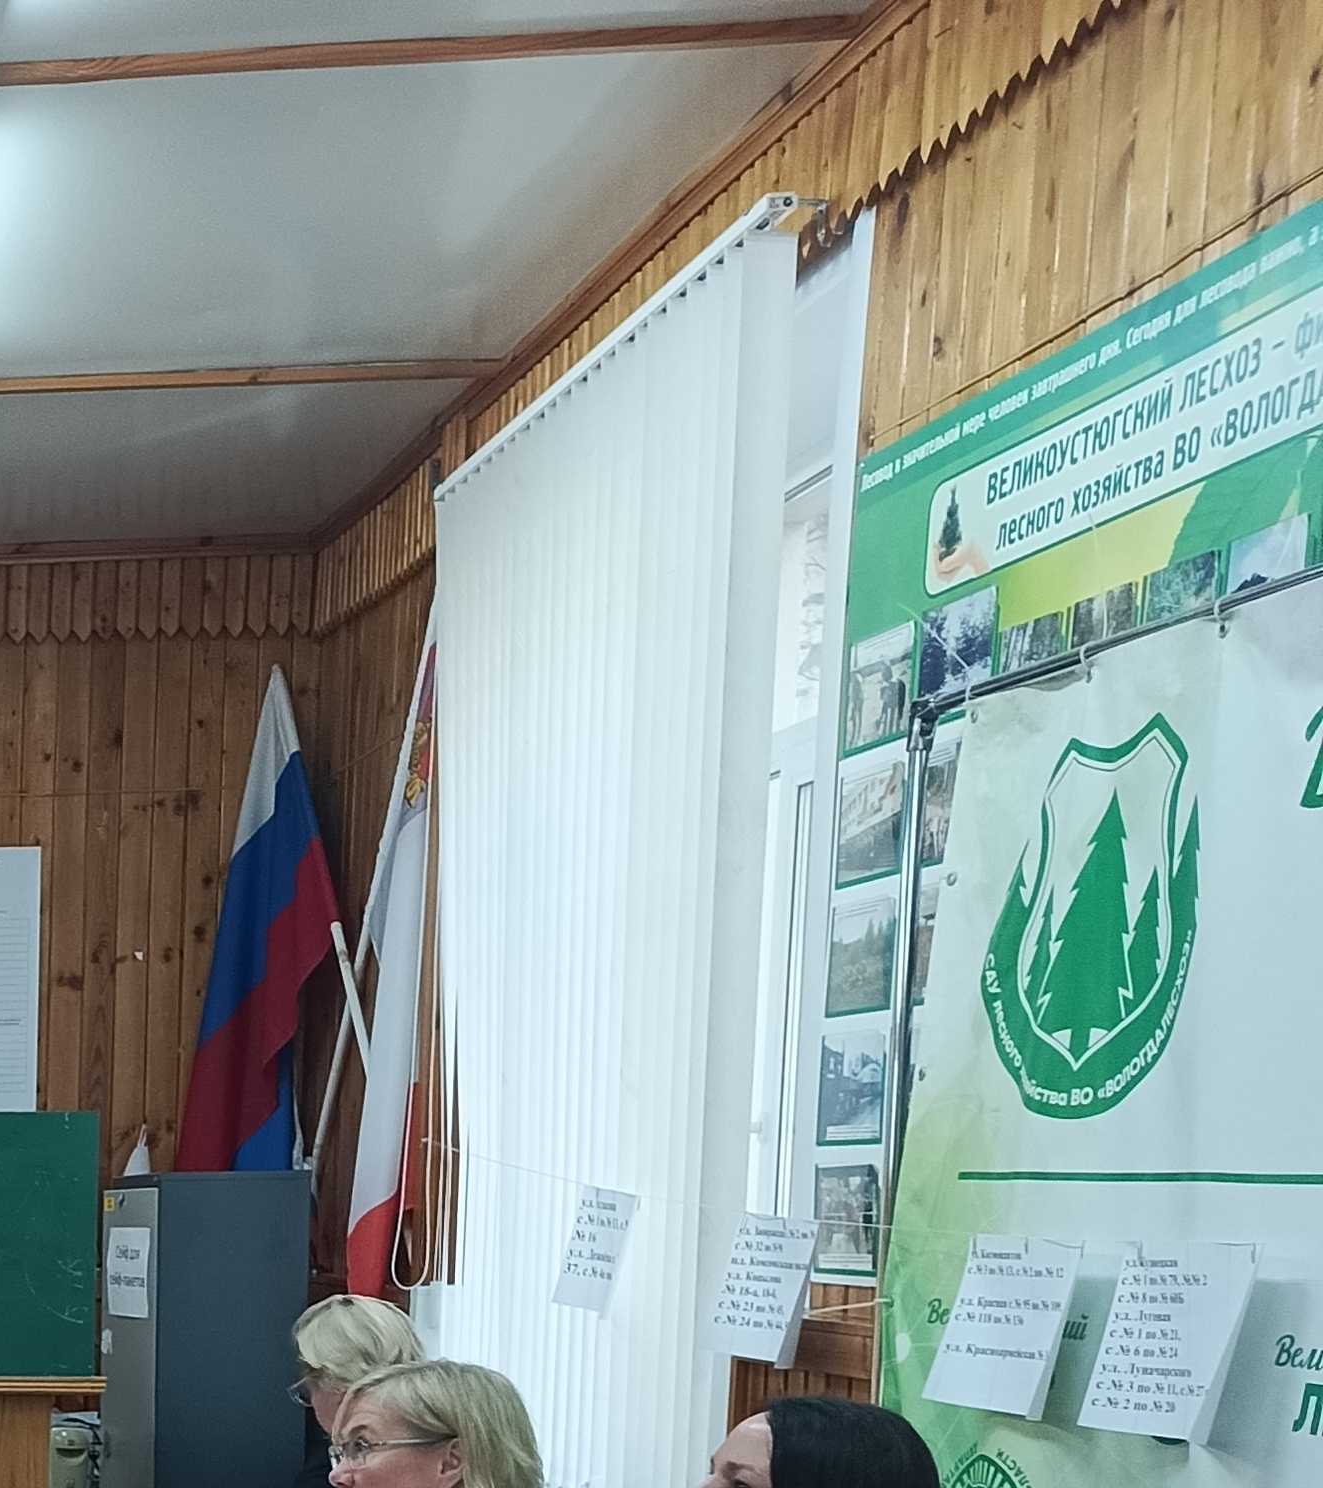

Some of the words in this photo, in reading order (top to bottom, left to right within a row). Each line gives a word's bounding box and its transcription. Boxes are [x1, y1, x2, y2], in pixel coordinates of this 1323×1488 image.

[988, 388, 1030, 422] человек
[1031, 352, 1096, 401] завтрашнего
[1126, 310, 1172, 349] Сегодня
[1173, 295, 1198, 326] для
[986, 377, 1174, 506] ВЕЛИКОУСТЮГСКИЙ
[1179, 337, 1262, 412] ЛЕСХОЗ
[995, 497, 1064, 551] лесного
[1071, 449, 1164, 518] хозяйства
[1172, 426, 1202, 471] ВО
[985, 953, 1002, 993] САУ
[992, 1000, 1022, 1067] лесного
[1097, 929, 1193, 1099] «ВОЛОГДАЛЕСХОЗ»
[1070, 1087, 1094, 1106] ВО
[1106, 1379, 1124, 1391] №
[1137, 1384, 1150, 1393] по
[1123, 1362, 1192, 1380] Луначарского
[1102, 1397, 1120, 1408] №
[1133, 1402, 1147, 1411] по
